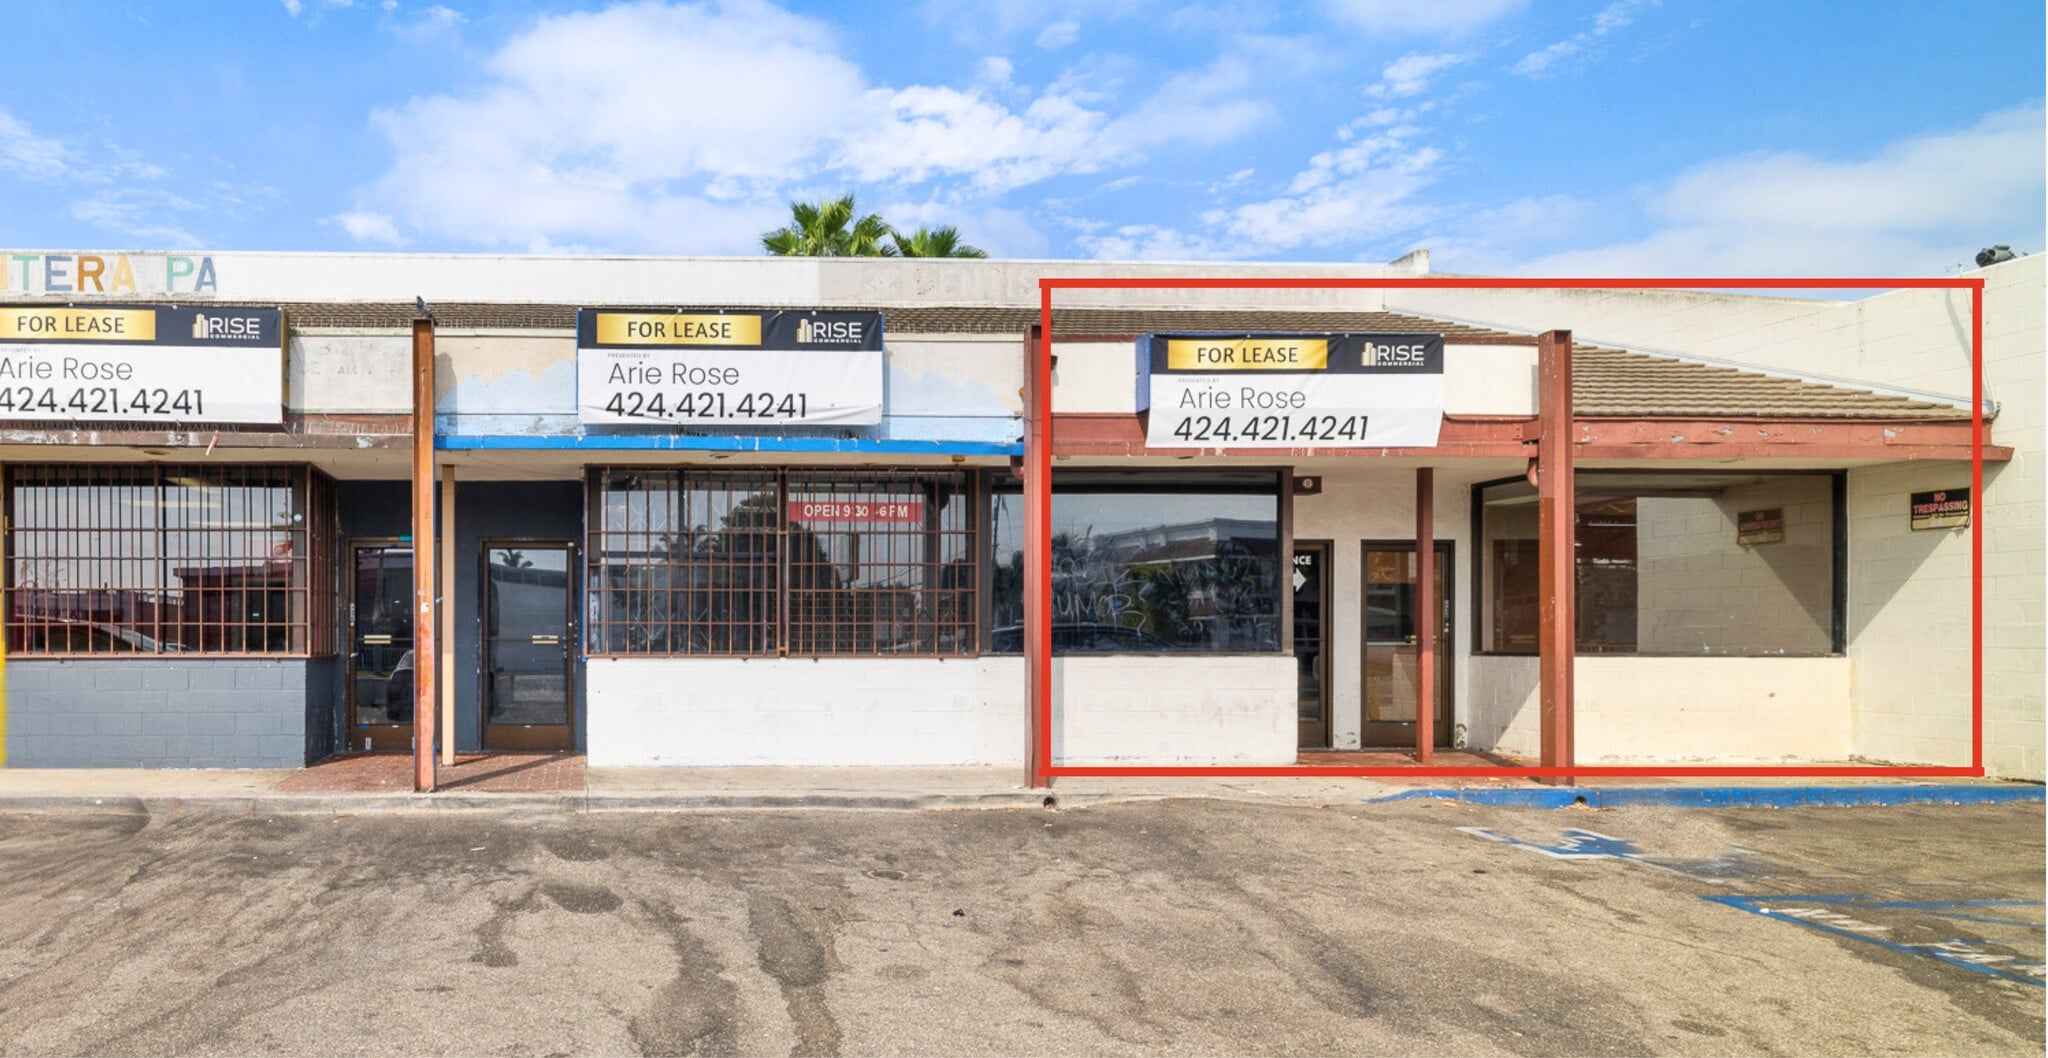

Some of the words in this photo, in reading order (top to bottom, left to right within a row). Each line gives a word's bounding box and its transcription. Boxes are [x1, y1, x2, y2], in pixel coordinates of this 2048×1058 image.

[0, 255, 137, 292] TERA
[17, 315, 57, 333] FOR
[65, 316, 125, 334] LEASE
[209, 317, 261, 334] RISE
[627, 321, 666, 339] FOR
[673, 321, 732, 339] LEASE
[812, 322, 862, 339] RISE
[1197, 347, 1235, 364] FOR
[1242, 347, 1299, 364] LEASE
[1377, 345, 1425, 361] RISE
[0, 356, 52, 380] Arie
[63, 357, 133, 381] Rose
[608, 361, 662, 386] Arie
[672, 362, 740, 386] Rose
[0, 386, 204, 415] 424.421.4241
[605, 391, 807, 419] 424.421.4241
[1179, 386, 1232, 409] Arie
[1240, 387, 1307, 410] Rose
[1173, 415, 1369, 441] 424.421.4241
[1933, 491, 1946, 502] NO
[803, 504, 840, 517] OPEN
[1913, 500, 1969, 515] TRESPASSING
